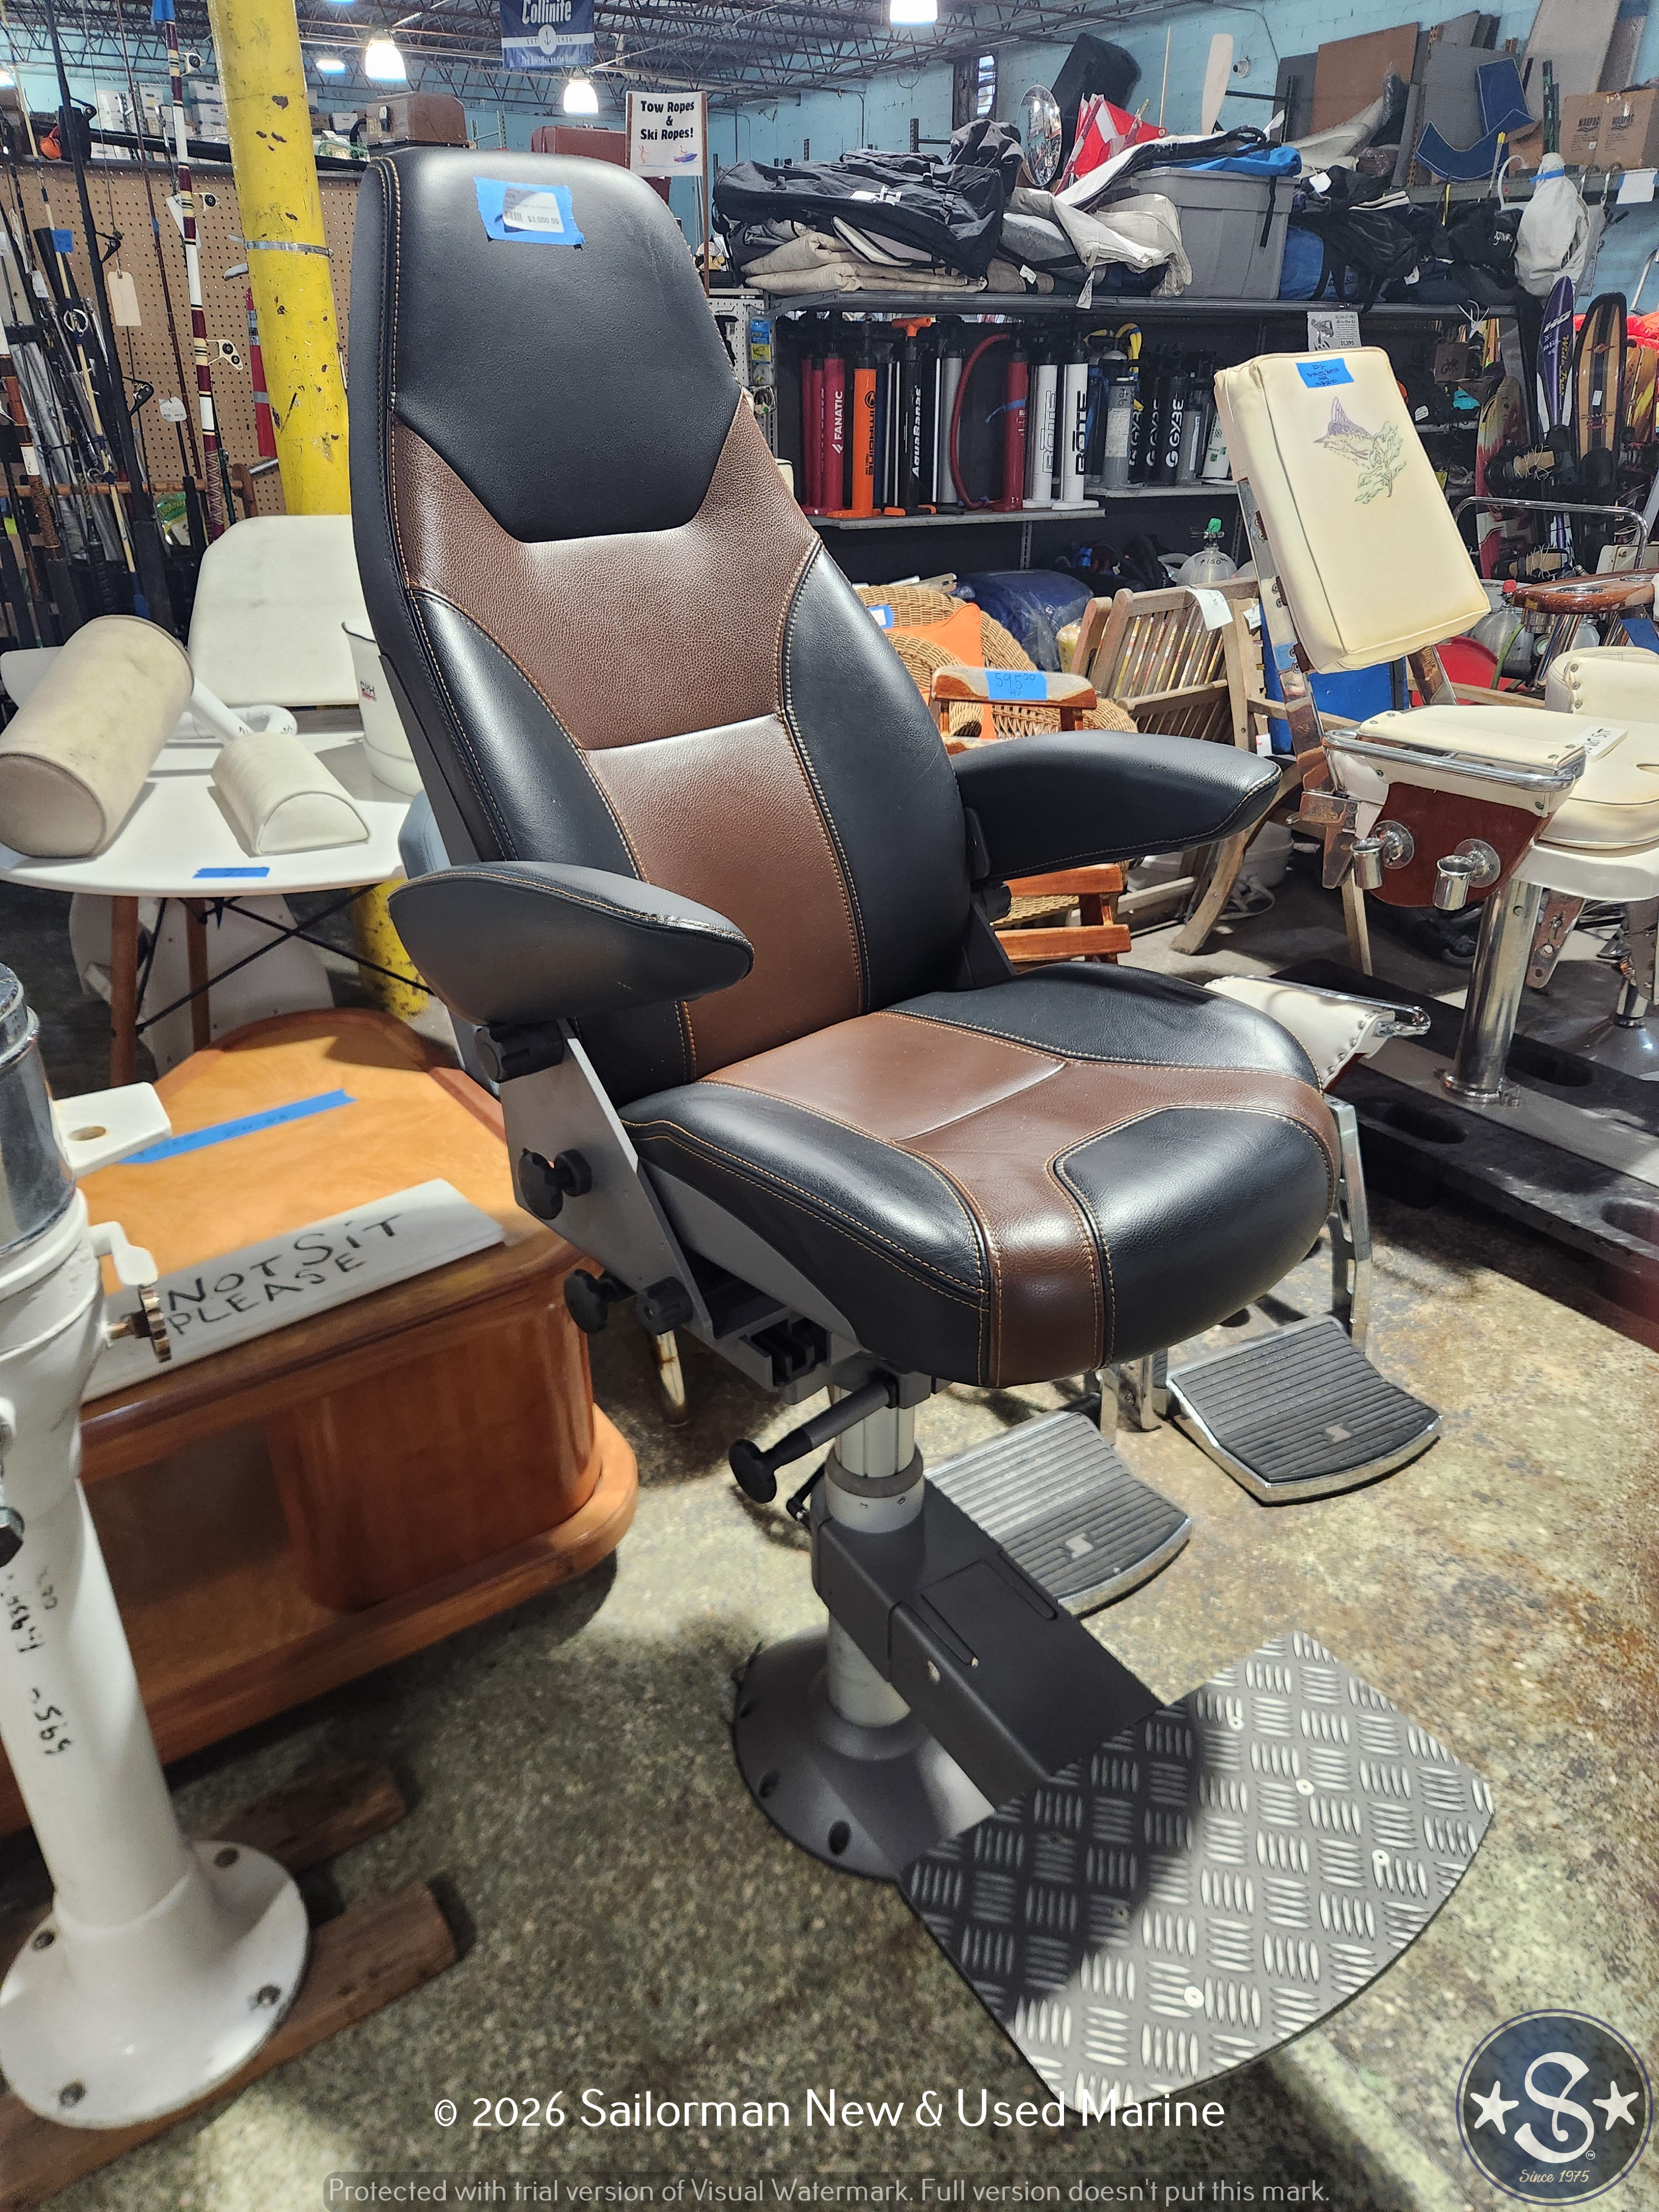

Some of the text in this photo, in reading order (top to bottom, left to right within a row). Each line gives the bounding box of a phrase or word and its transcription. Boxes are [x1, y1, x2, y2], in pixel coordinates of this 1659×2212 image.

[641, 101, 694, 113] Tow Ropes
[666, 116, 673, 126] &
[640, 127, 693, 140] Ski Ropes!
[834, 390, 843, 440] FANATIC
[165, 1252, 367, 1335] PLEASE
[168, 1255, 283, 1312] NOT
